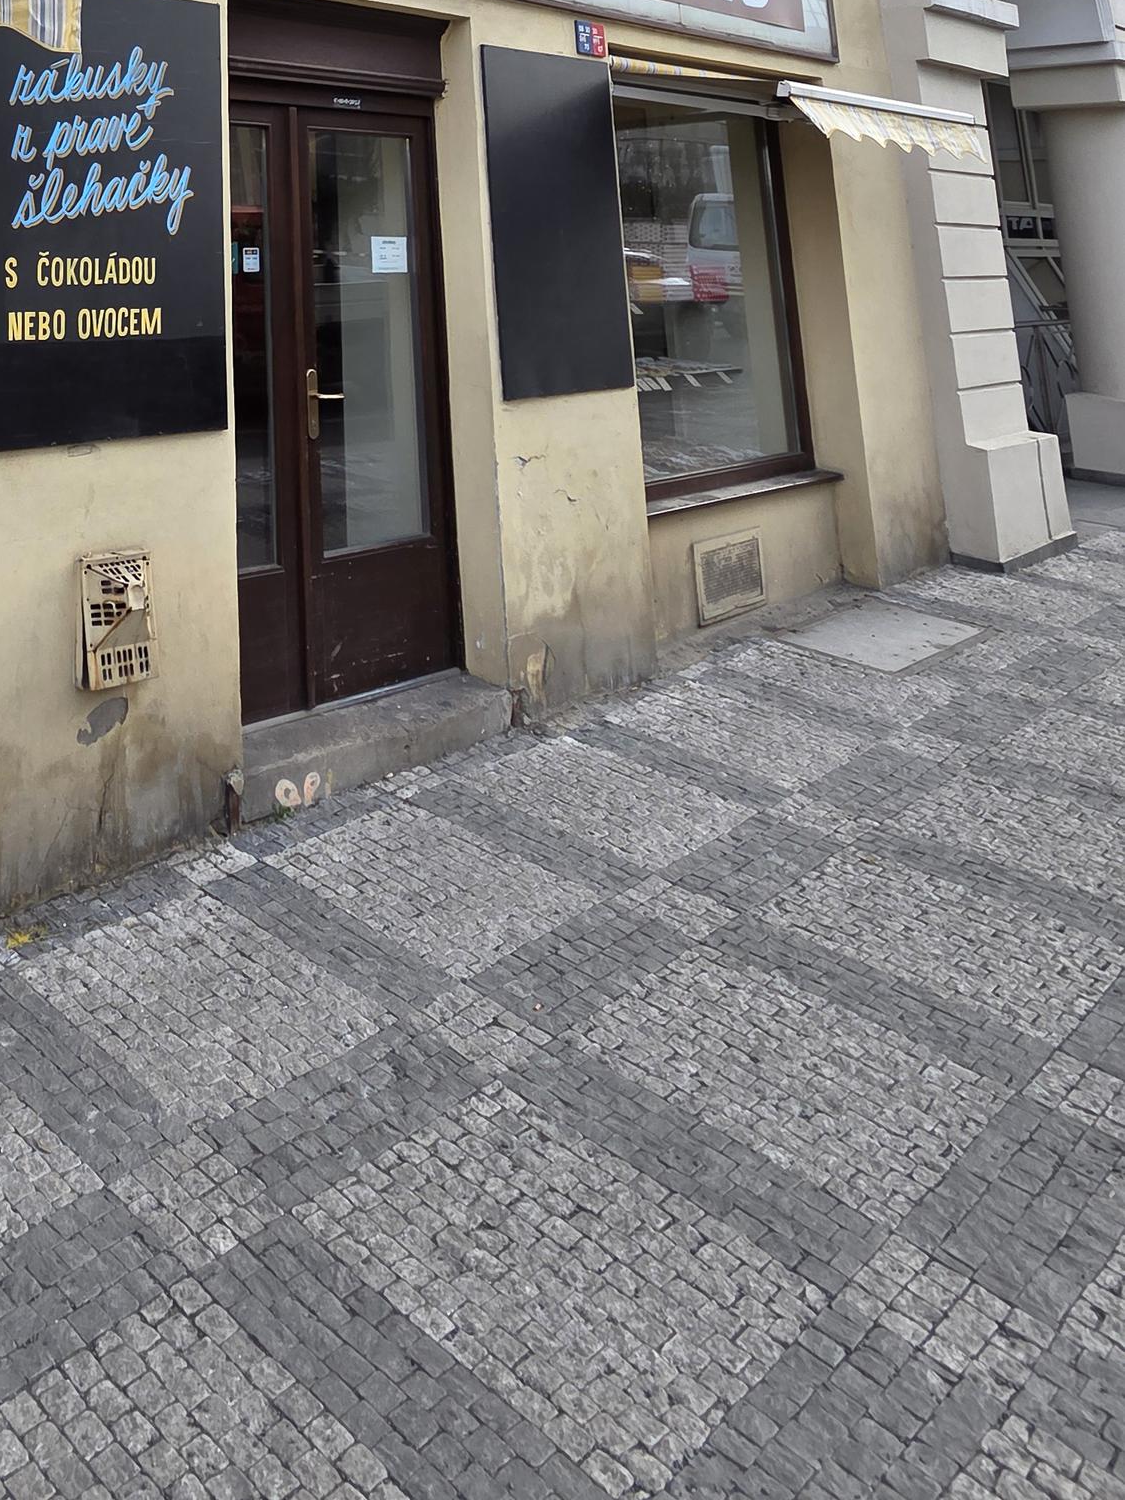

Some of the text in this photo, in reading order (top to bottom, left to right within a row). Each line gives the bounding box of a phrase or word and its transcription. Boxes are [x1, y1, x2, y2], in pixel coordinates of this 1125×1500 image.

[11, 153, 194, 236] šlehačky
[4, 251, 156, 289] S ČOKOLÁDOU
[8, 307, 162, 341] NEBO OVOCEM
